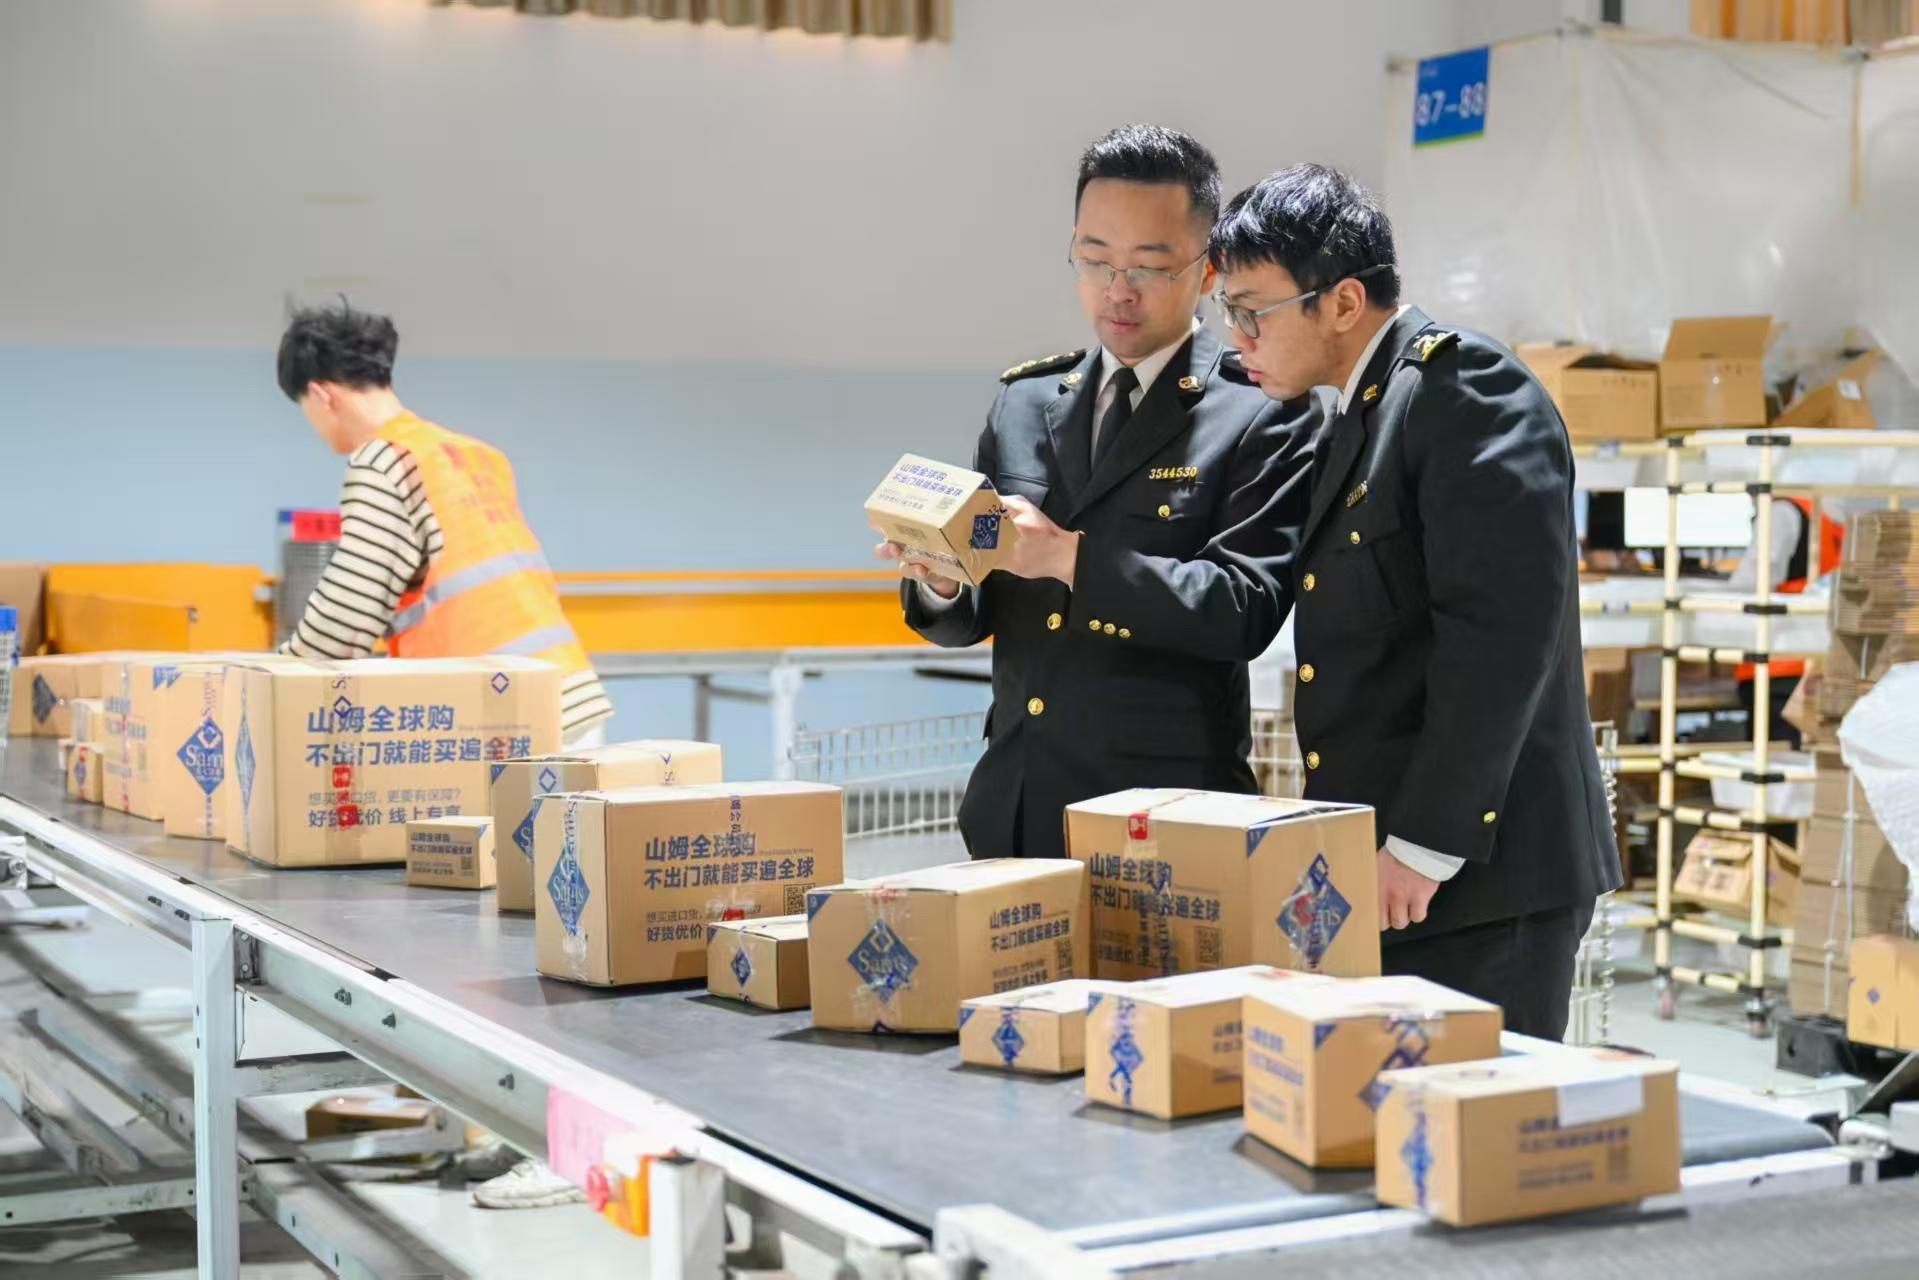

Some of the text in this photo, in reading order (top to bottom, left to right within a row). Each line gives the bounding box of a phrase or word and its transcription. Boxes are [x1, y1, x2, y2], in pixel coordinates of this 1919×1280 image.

[1149, 466, 1198, 480] 3544530
[307, 704, 455, 735] 山姆全球购
[305, 736, 532, 768] 不出门就能买遍全球
[645, 832, 757, 862] 山姆全球购
[644, 857, 815, 890] 不出门就能买遍全球
[990, 903, 1042, 929] 山姆全球购
[648, 922, 703, 943] 好货优价
